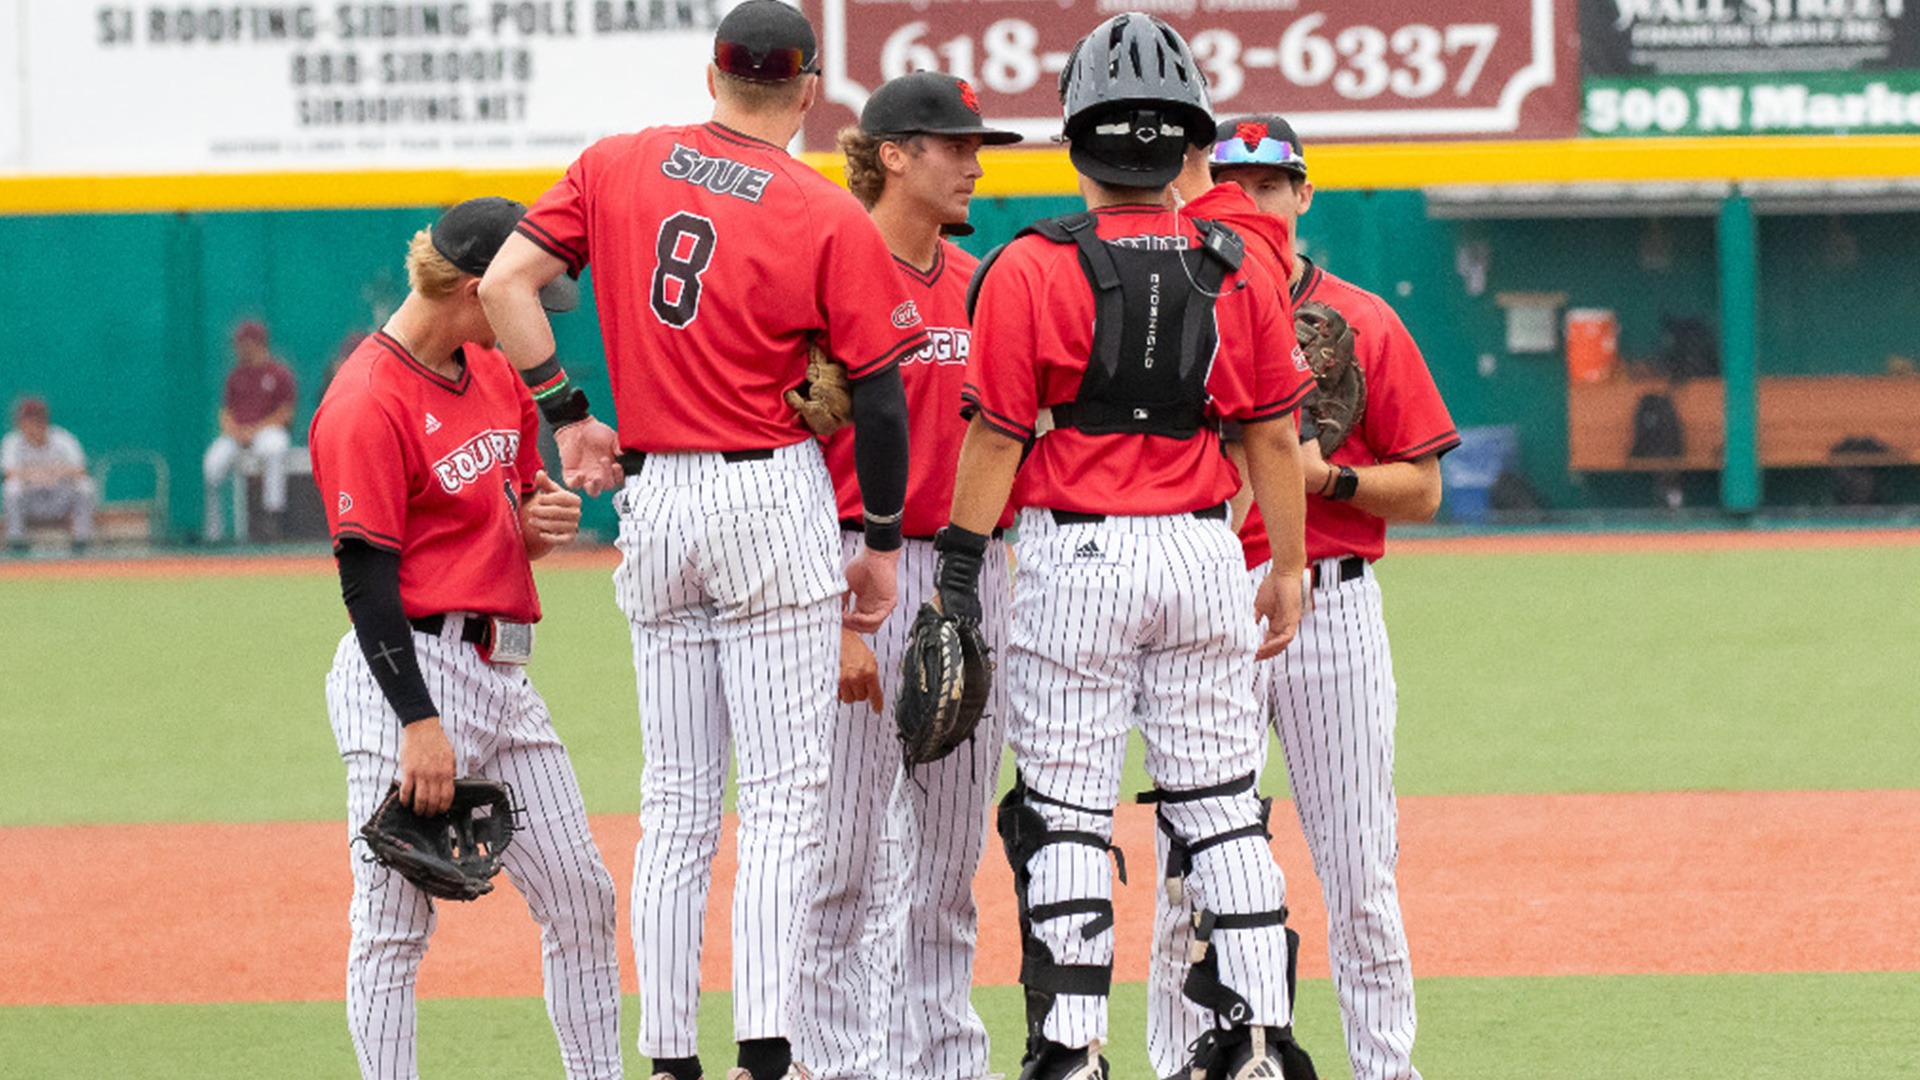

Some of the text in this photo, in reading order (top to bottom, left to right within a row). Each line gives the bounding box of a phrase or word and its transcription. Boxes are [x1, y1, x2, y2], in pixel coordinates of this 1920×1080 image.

[1586, 87, 1690, 132] 500
[1698, 85, 1743, 130] N
[661, 142, 775, 202] SIUE
[650, 210, 717, 330] 8
